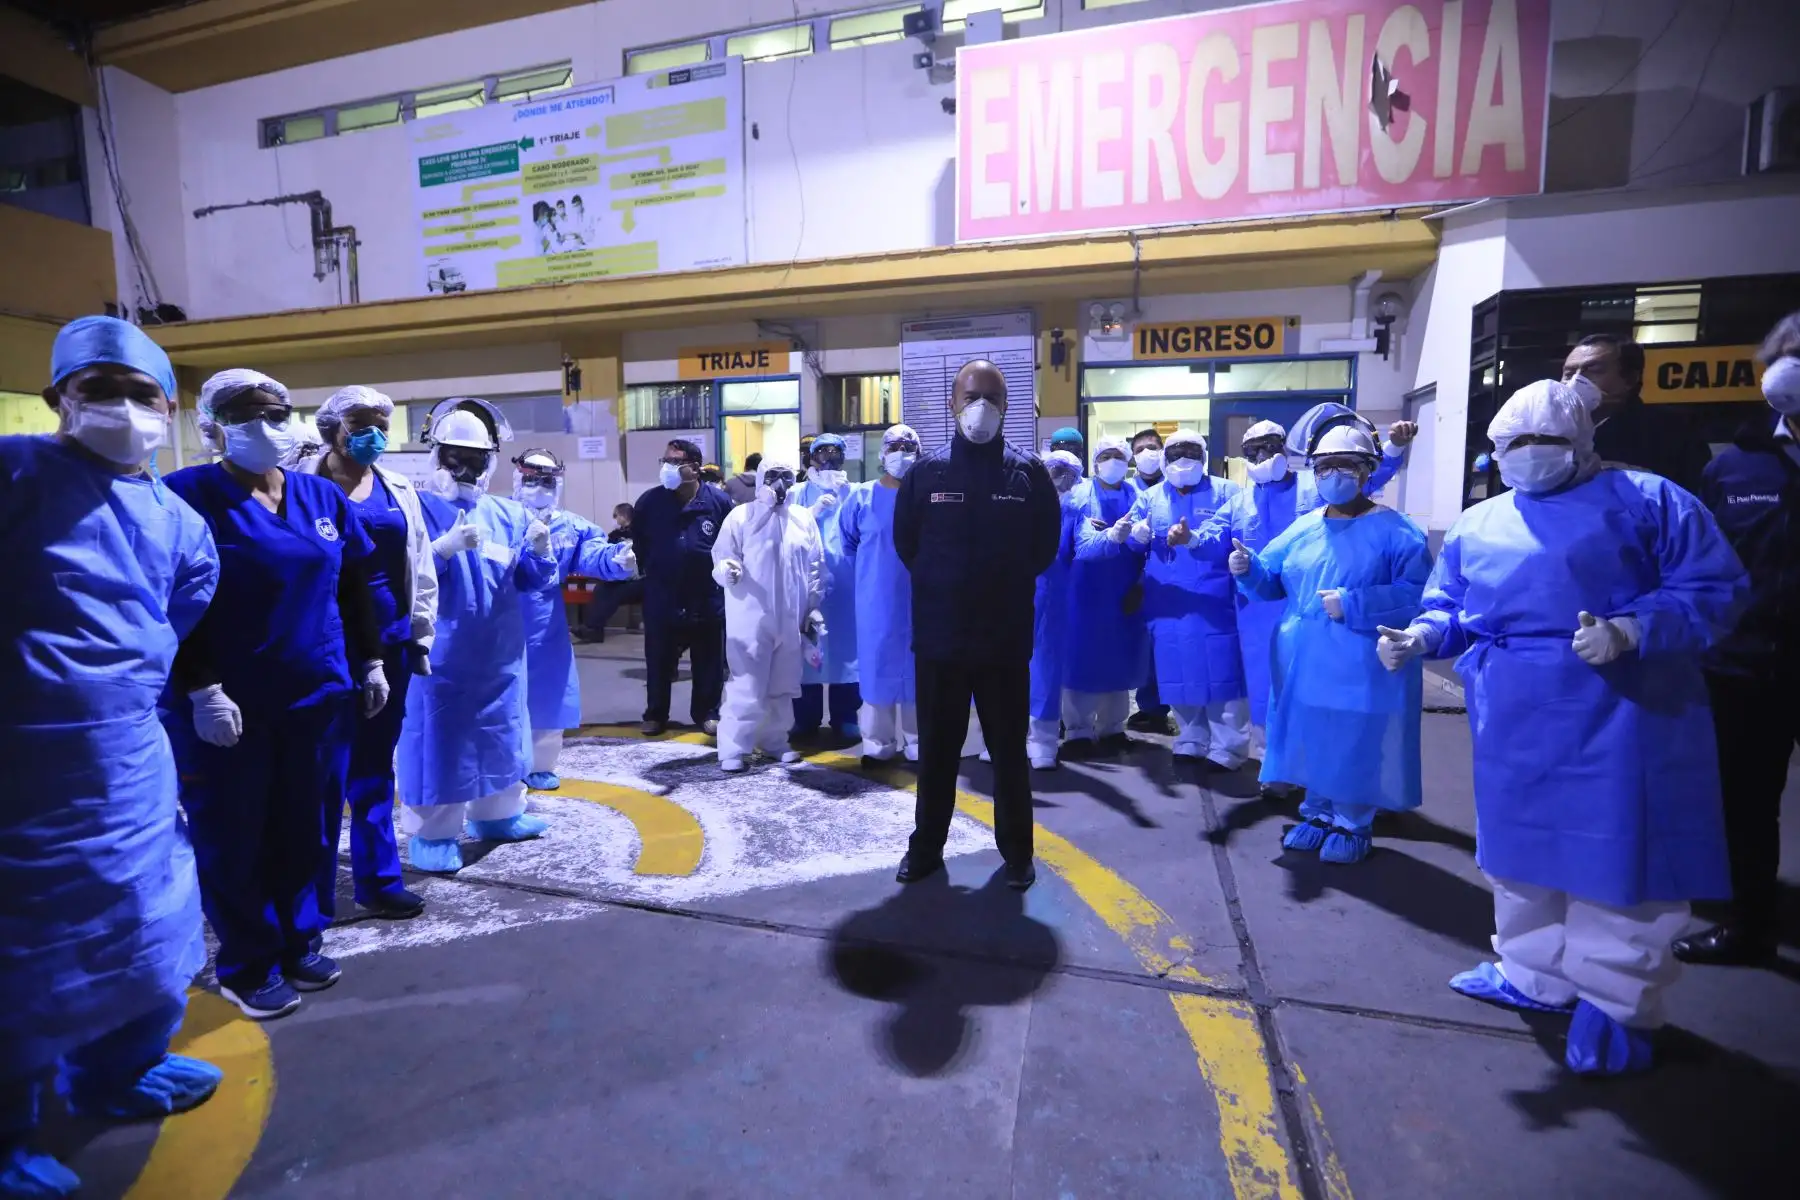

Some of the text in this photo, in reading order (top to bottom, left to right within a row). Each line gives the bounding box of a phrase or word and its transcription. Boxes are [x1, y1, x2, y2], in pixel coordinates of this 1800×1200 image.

[550, 102, 562, 113] ME
[566, 93, 610, 109] ATIENDO?
[970, 0, 1526, 220] EMERGENCIA
[550, 131, 580, 143] TRIAJE
[552, 157, 589, 169] MODERADO
[1140, 323, 1275, 354] INGRESO
[698, 350, 769, 371] TRIAJE
[1657, 359, 1755, 390] CAJA
